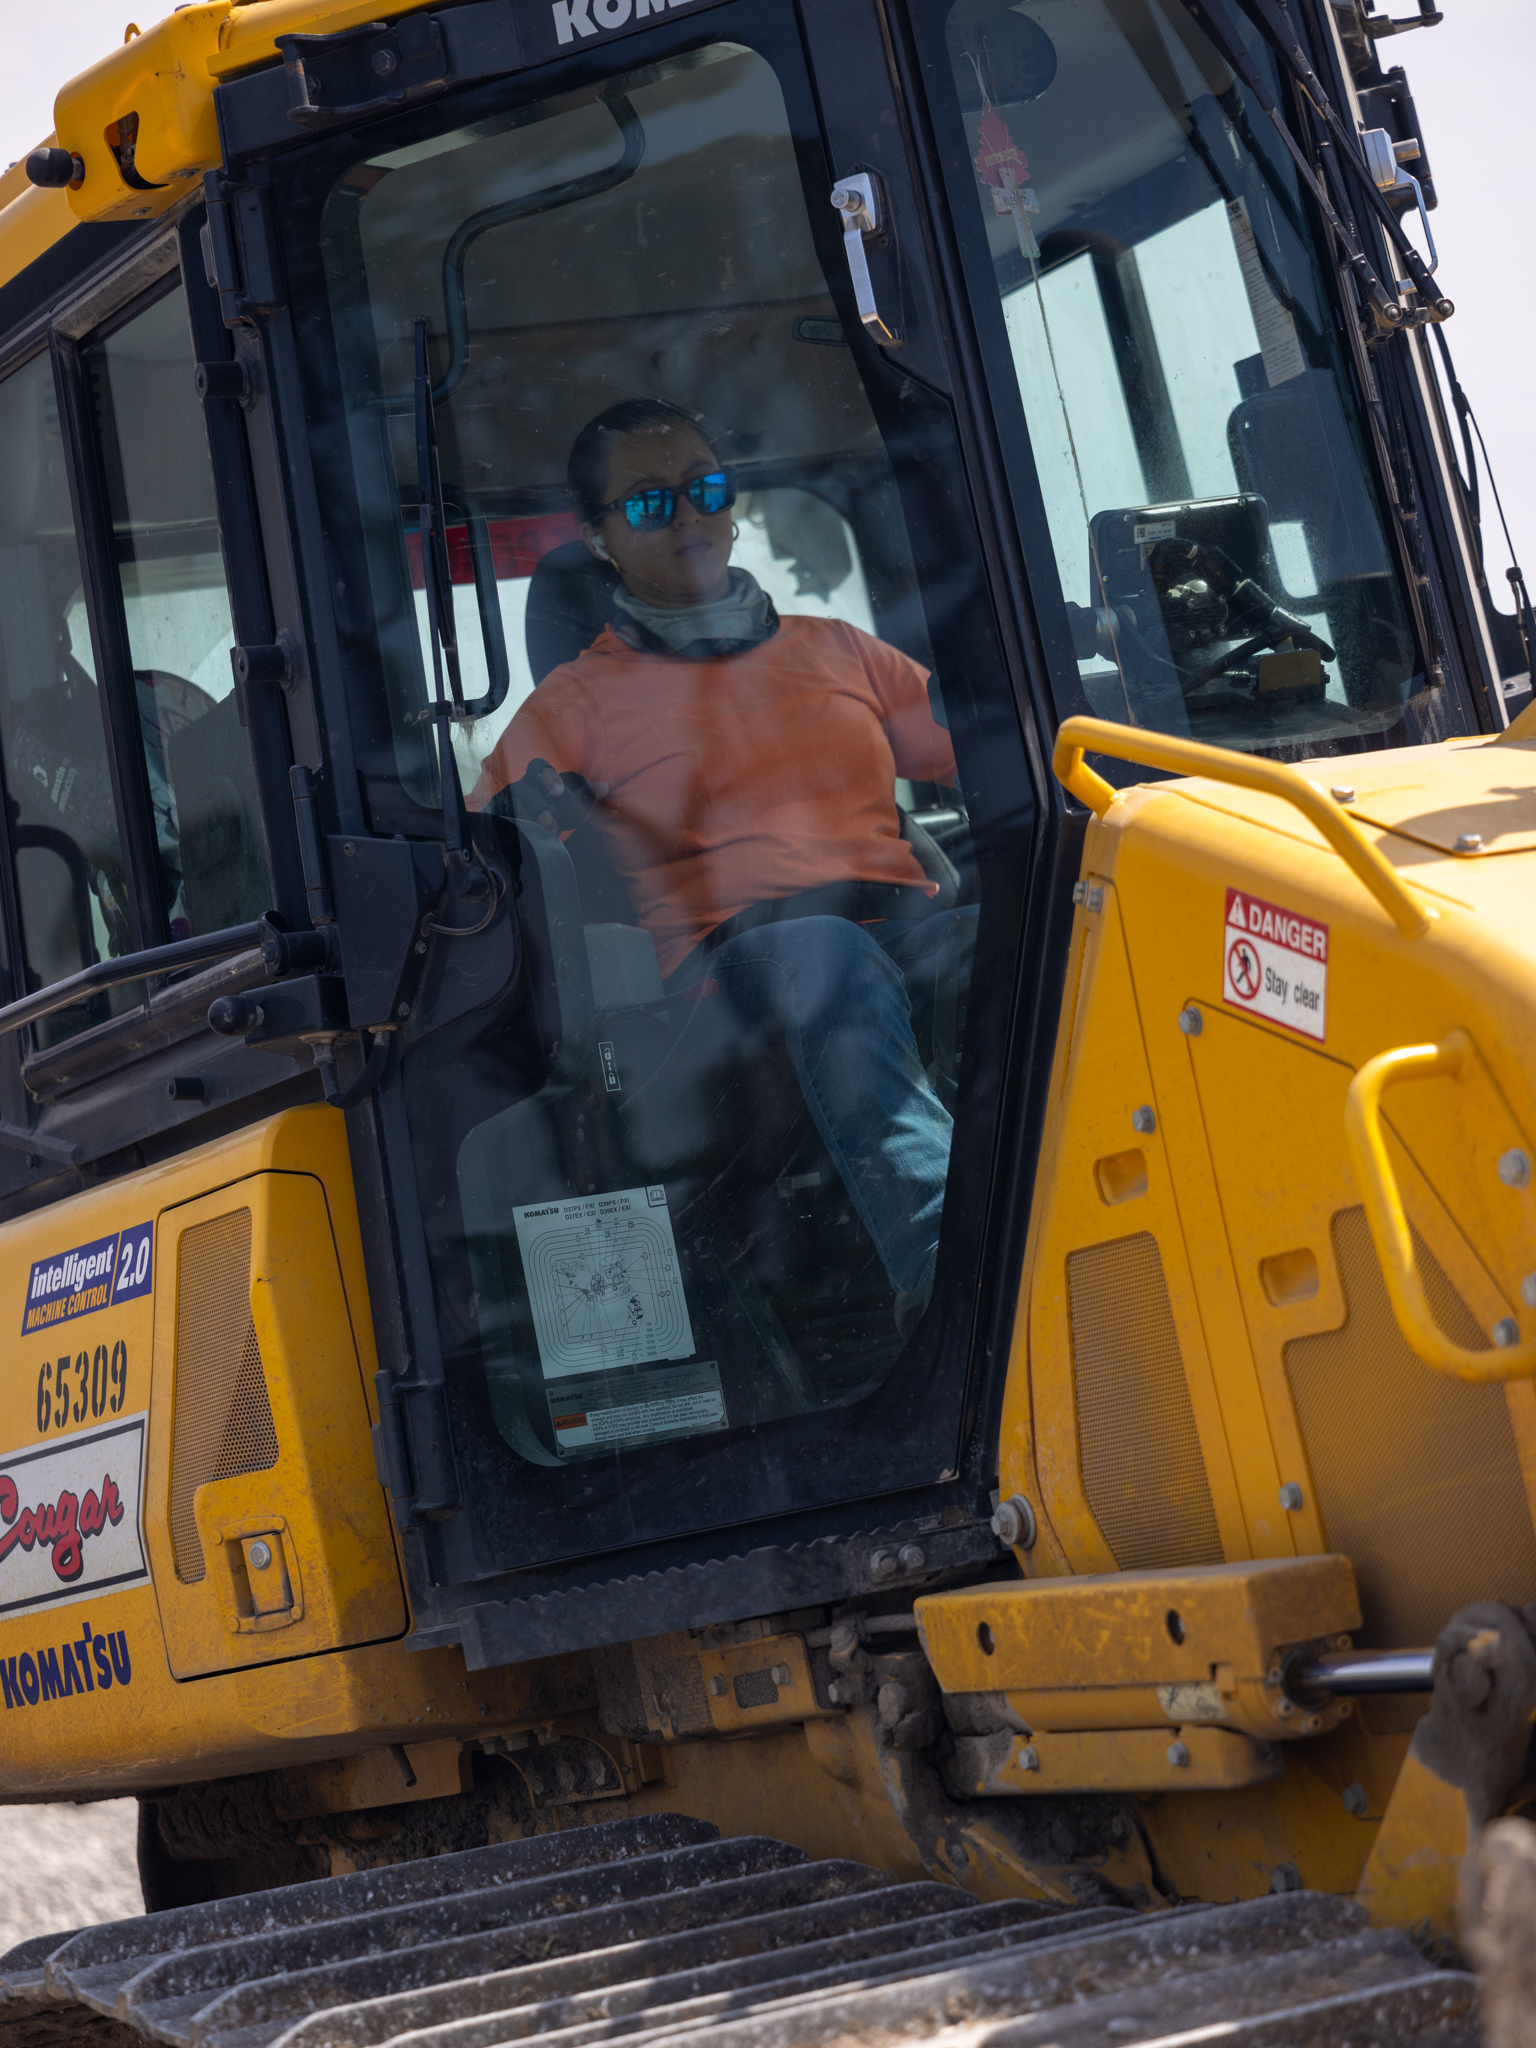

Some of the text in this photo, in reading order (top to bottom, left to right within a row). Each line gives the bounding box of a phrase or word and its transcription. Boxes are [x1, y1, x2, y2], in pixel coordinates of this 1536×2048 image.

[1003, 196, 1030, 206] BLESED
[1249, 904, 1327, 961] DANGER
[1265, 967, 1320, 1012] Stay clear
[523, 1207, 559, 1218] KOMATSU
[30, 1235, 150, 1301] intelligent 2.0
[26, 1283, 108, 1331] MACHINE CONTROL
[37, 1339, 128, 1434] 65309
[551, 1393, 582, 1403] KOMATSU
[562, 1417, 586, 1426] WARNING
[0, 1473, 125, 1583] Cougar
[0, 1621, 132, 1709] KOMATSU
